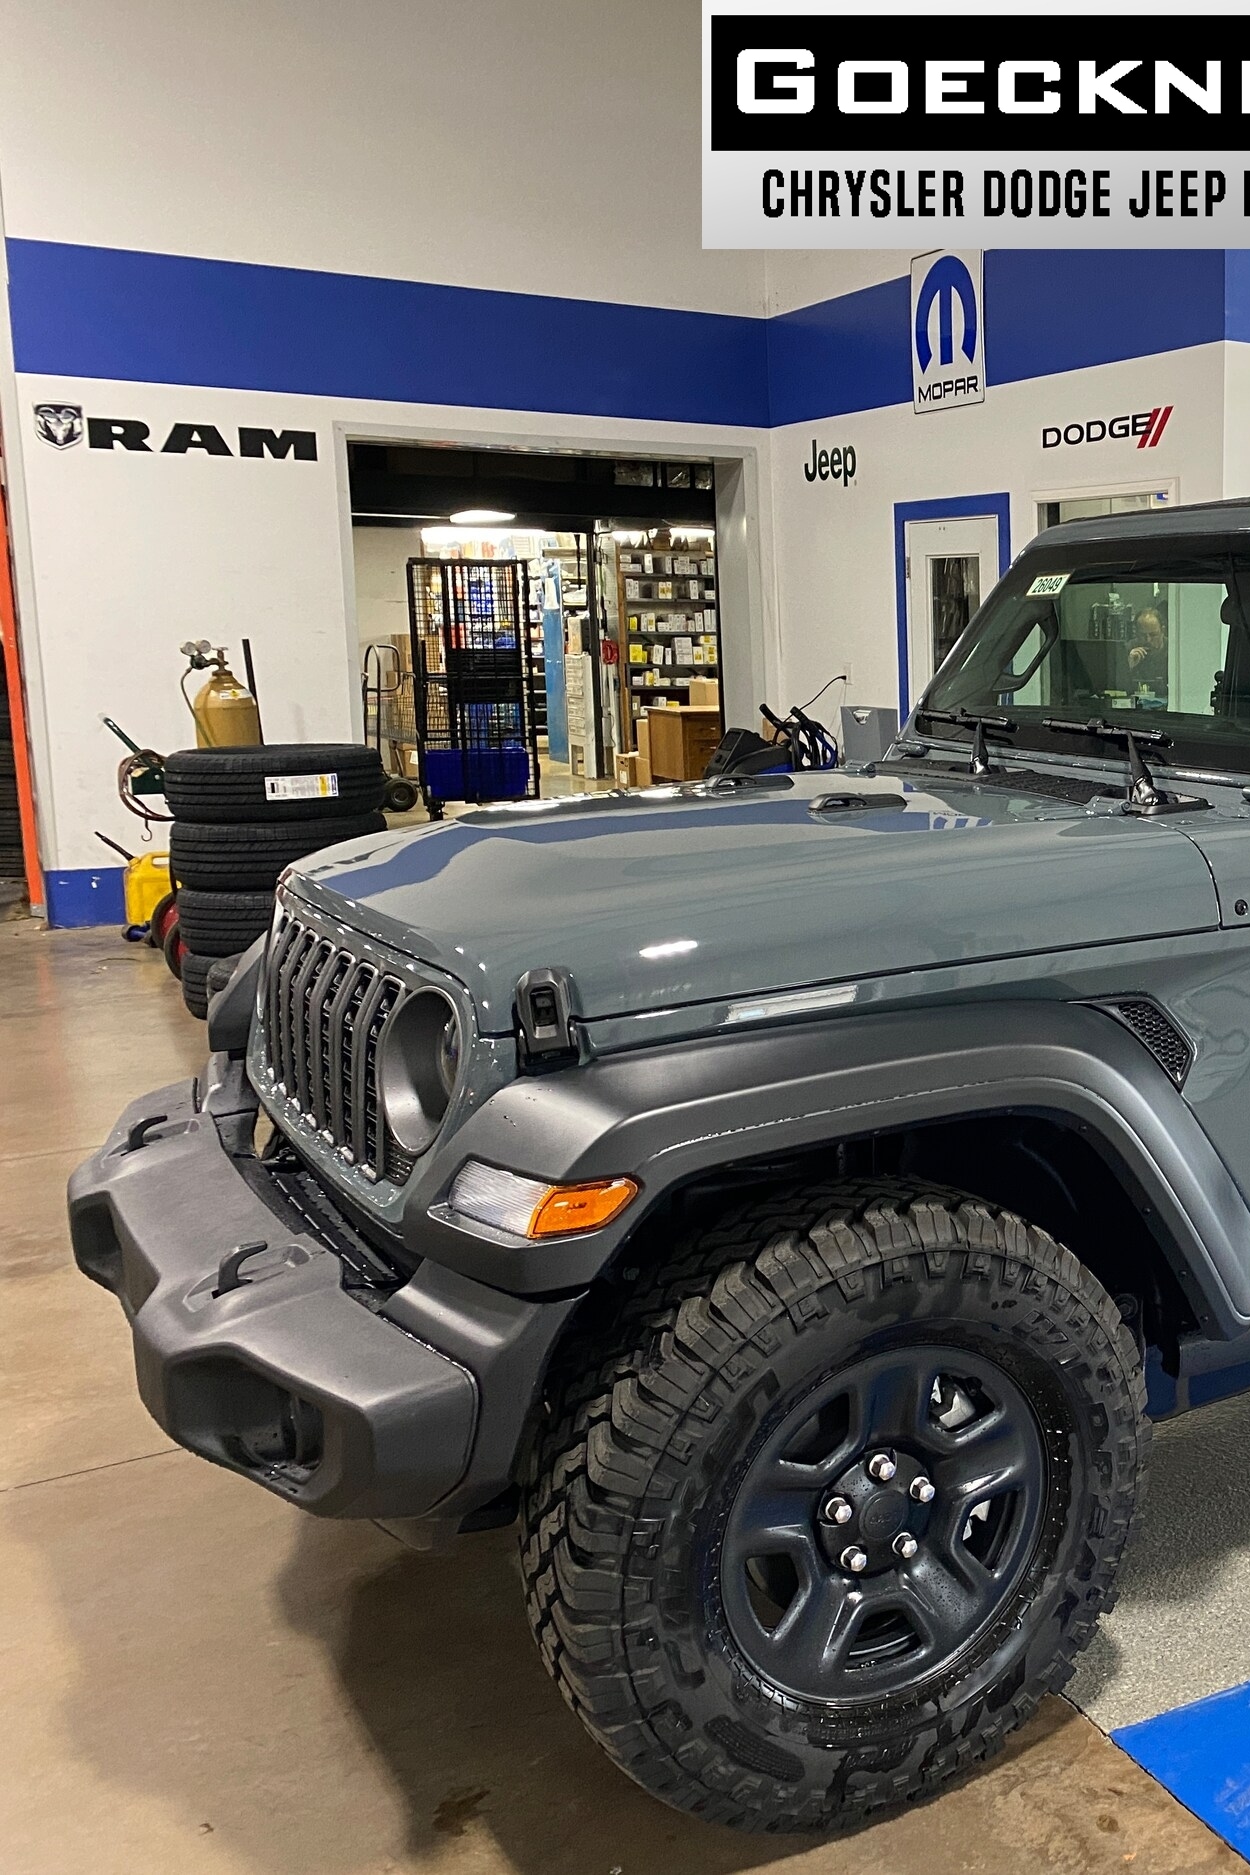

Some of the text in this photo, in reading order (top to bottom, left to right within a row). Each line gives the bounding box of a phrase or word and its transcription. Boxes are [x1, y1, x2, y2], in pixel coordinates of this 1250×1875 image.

[918, 375, 979, 404] MOPAR
[86, 417, 318, 462] RAM
[1042, 412, 1153, 449] DODGE
[804, 439, 857, 487] Jeep
[1031, 576, 1063, 593] 26049
